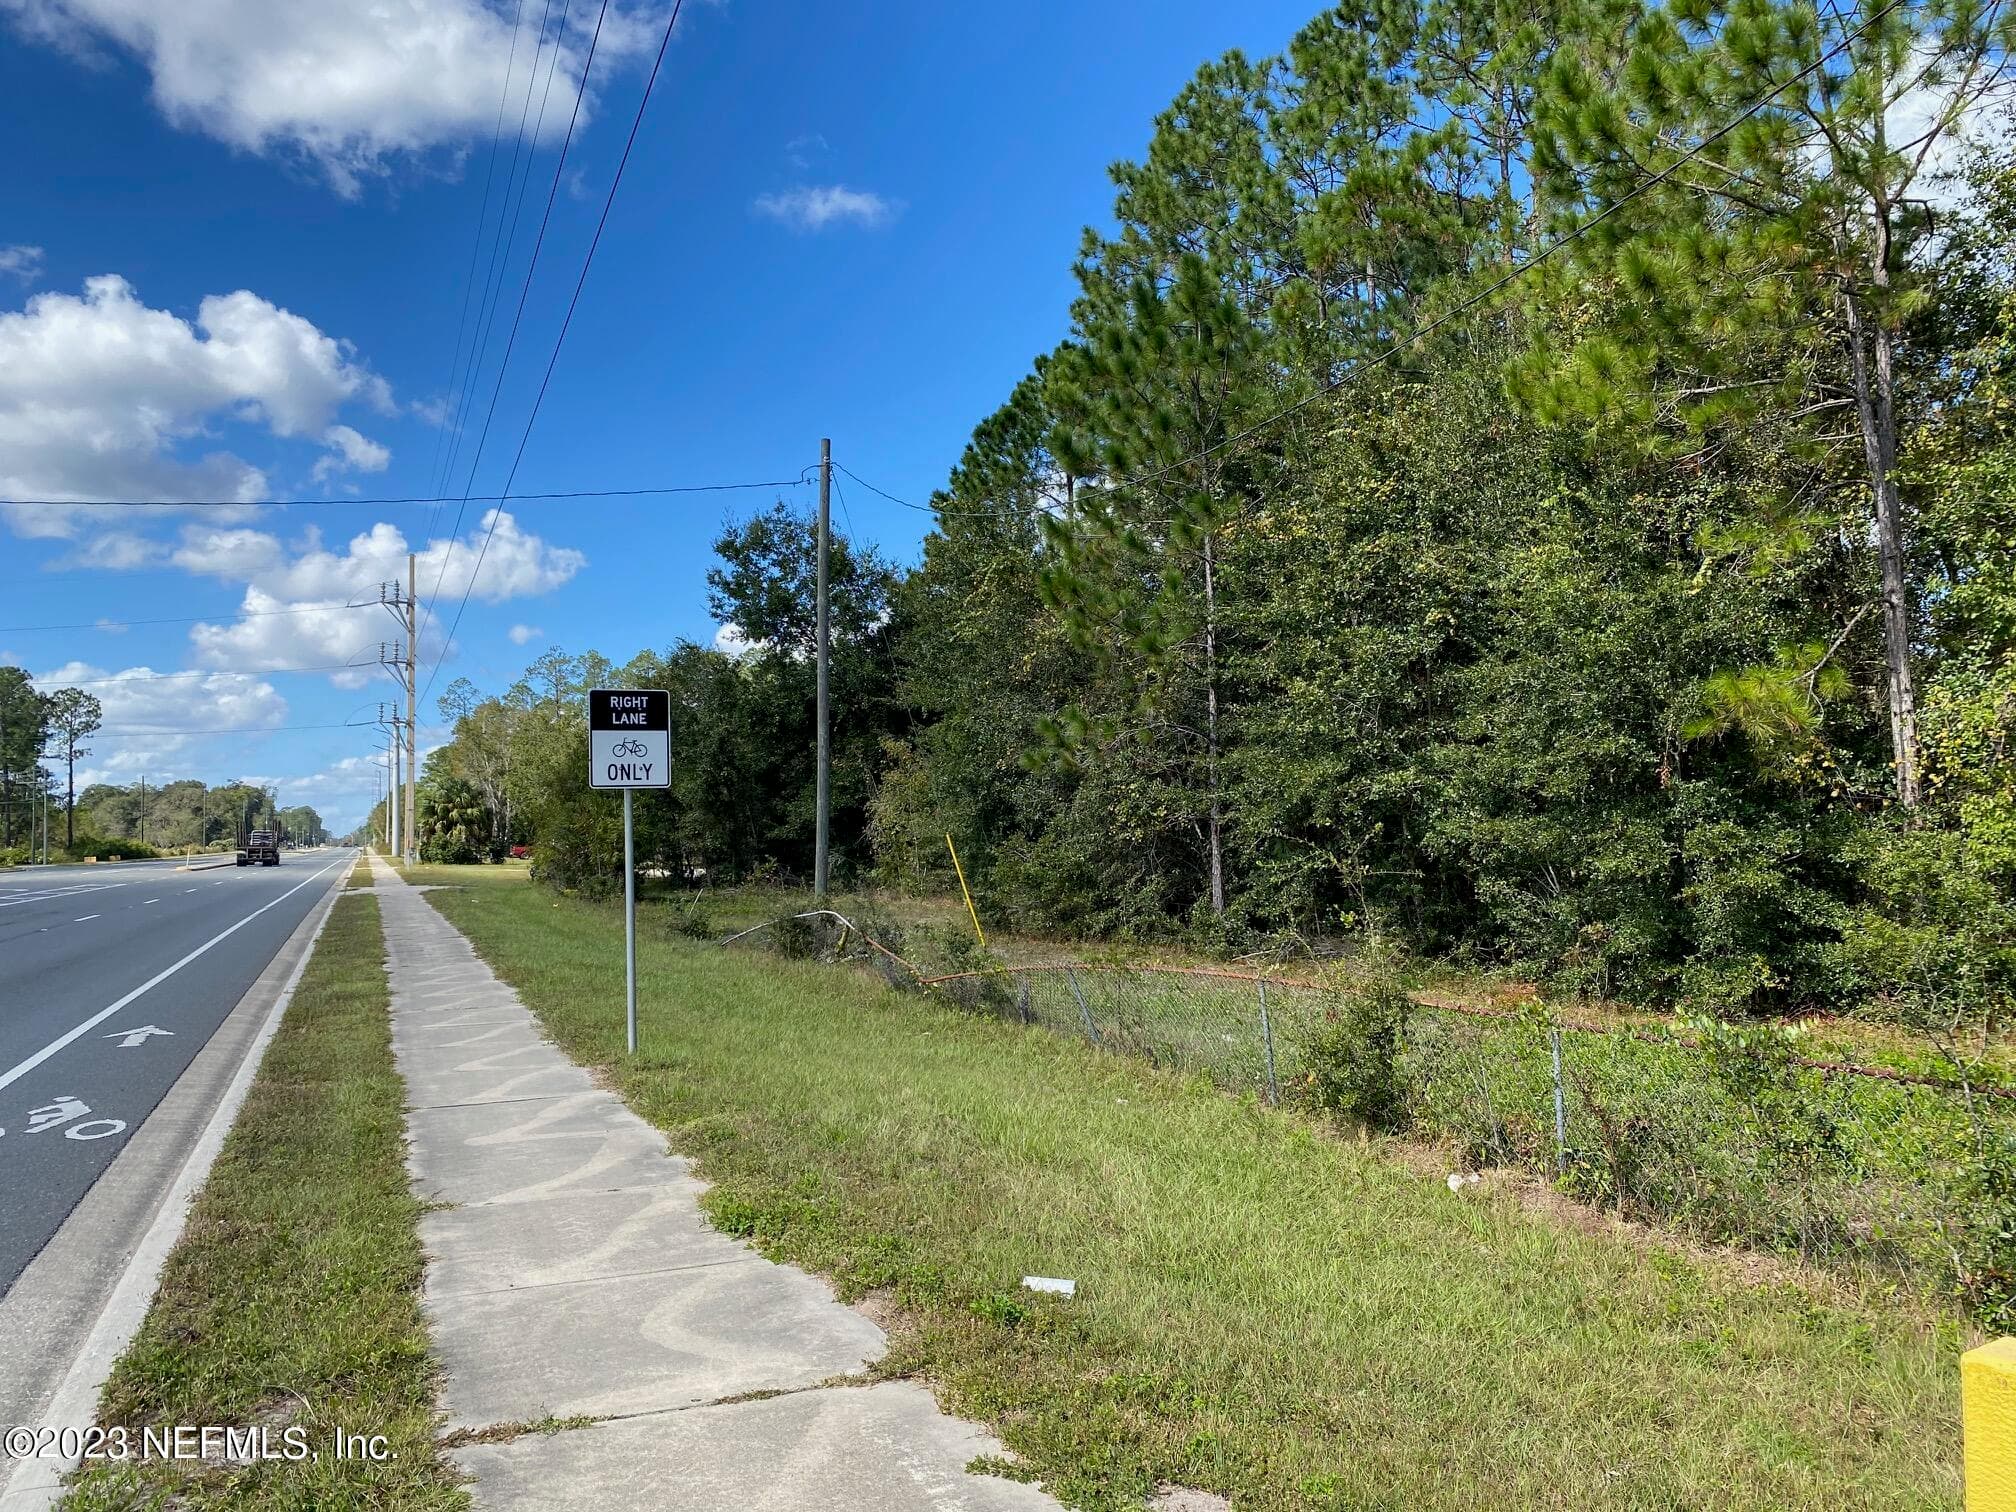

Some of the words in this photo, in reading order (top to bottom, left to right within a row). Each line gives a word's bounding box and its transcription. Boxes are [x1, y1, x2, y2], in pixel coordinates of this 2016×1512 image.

[610, 696, 649, 708] RIGHT
[612, 712, 648, 725] LANE
[607, 763, 653, 781] ONLY
